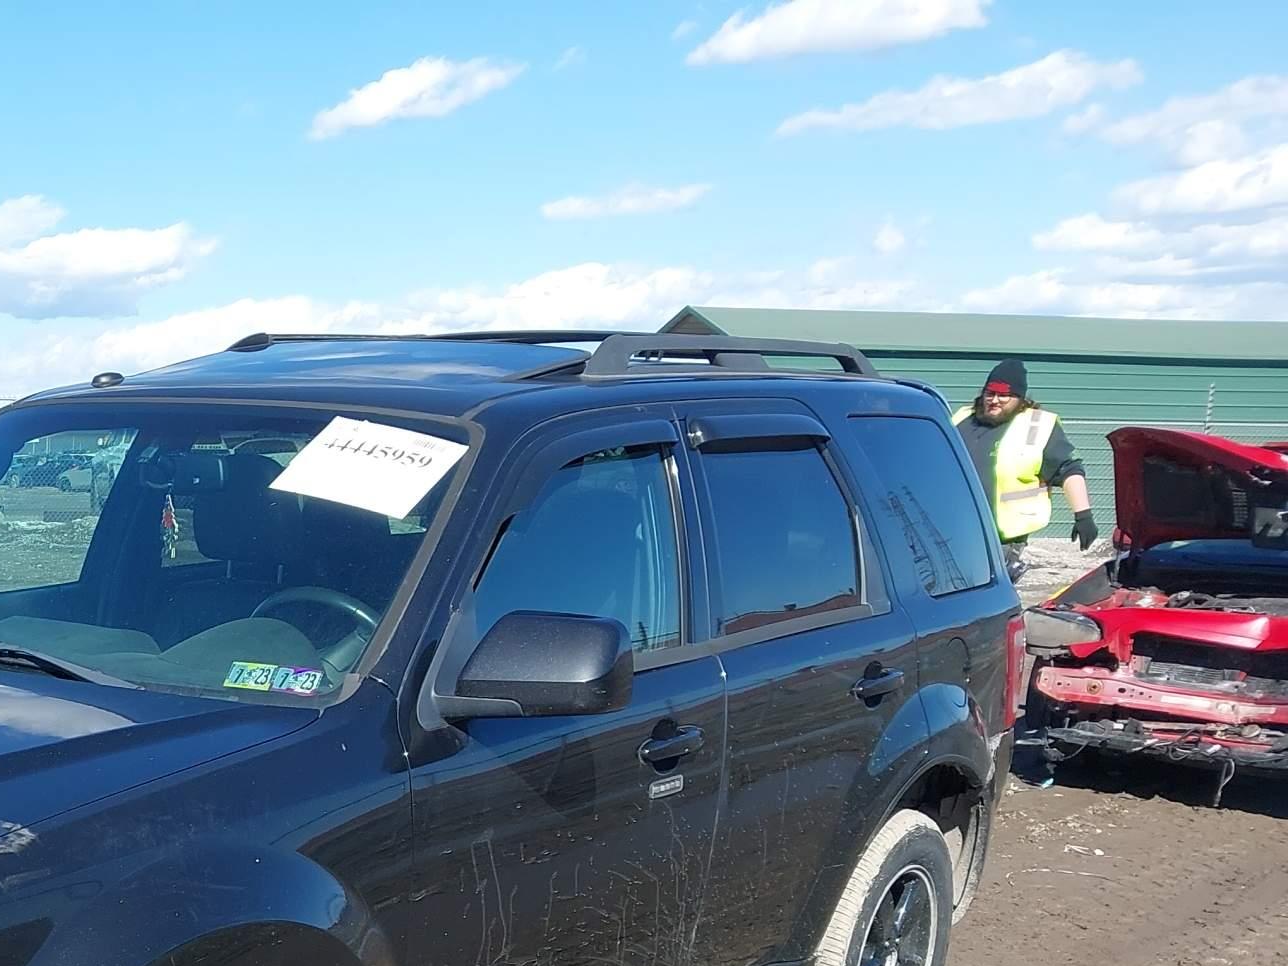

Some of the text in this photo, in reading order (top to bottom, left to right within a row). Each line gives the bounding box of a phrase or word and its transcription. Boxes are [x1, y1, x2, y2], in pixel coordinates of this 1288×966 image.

[324, 438, 433, 468] 44445959
[254, 668, 271, 685] 23
[300, 673, 317, 691] 23
